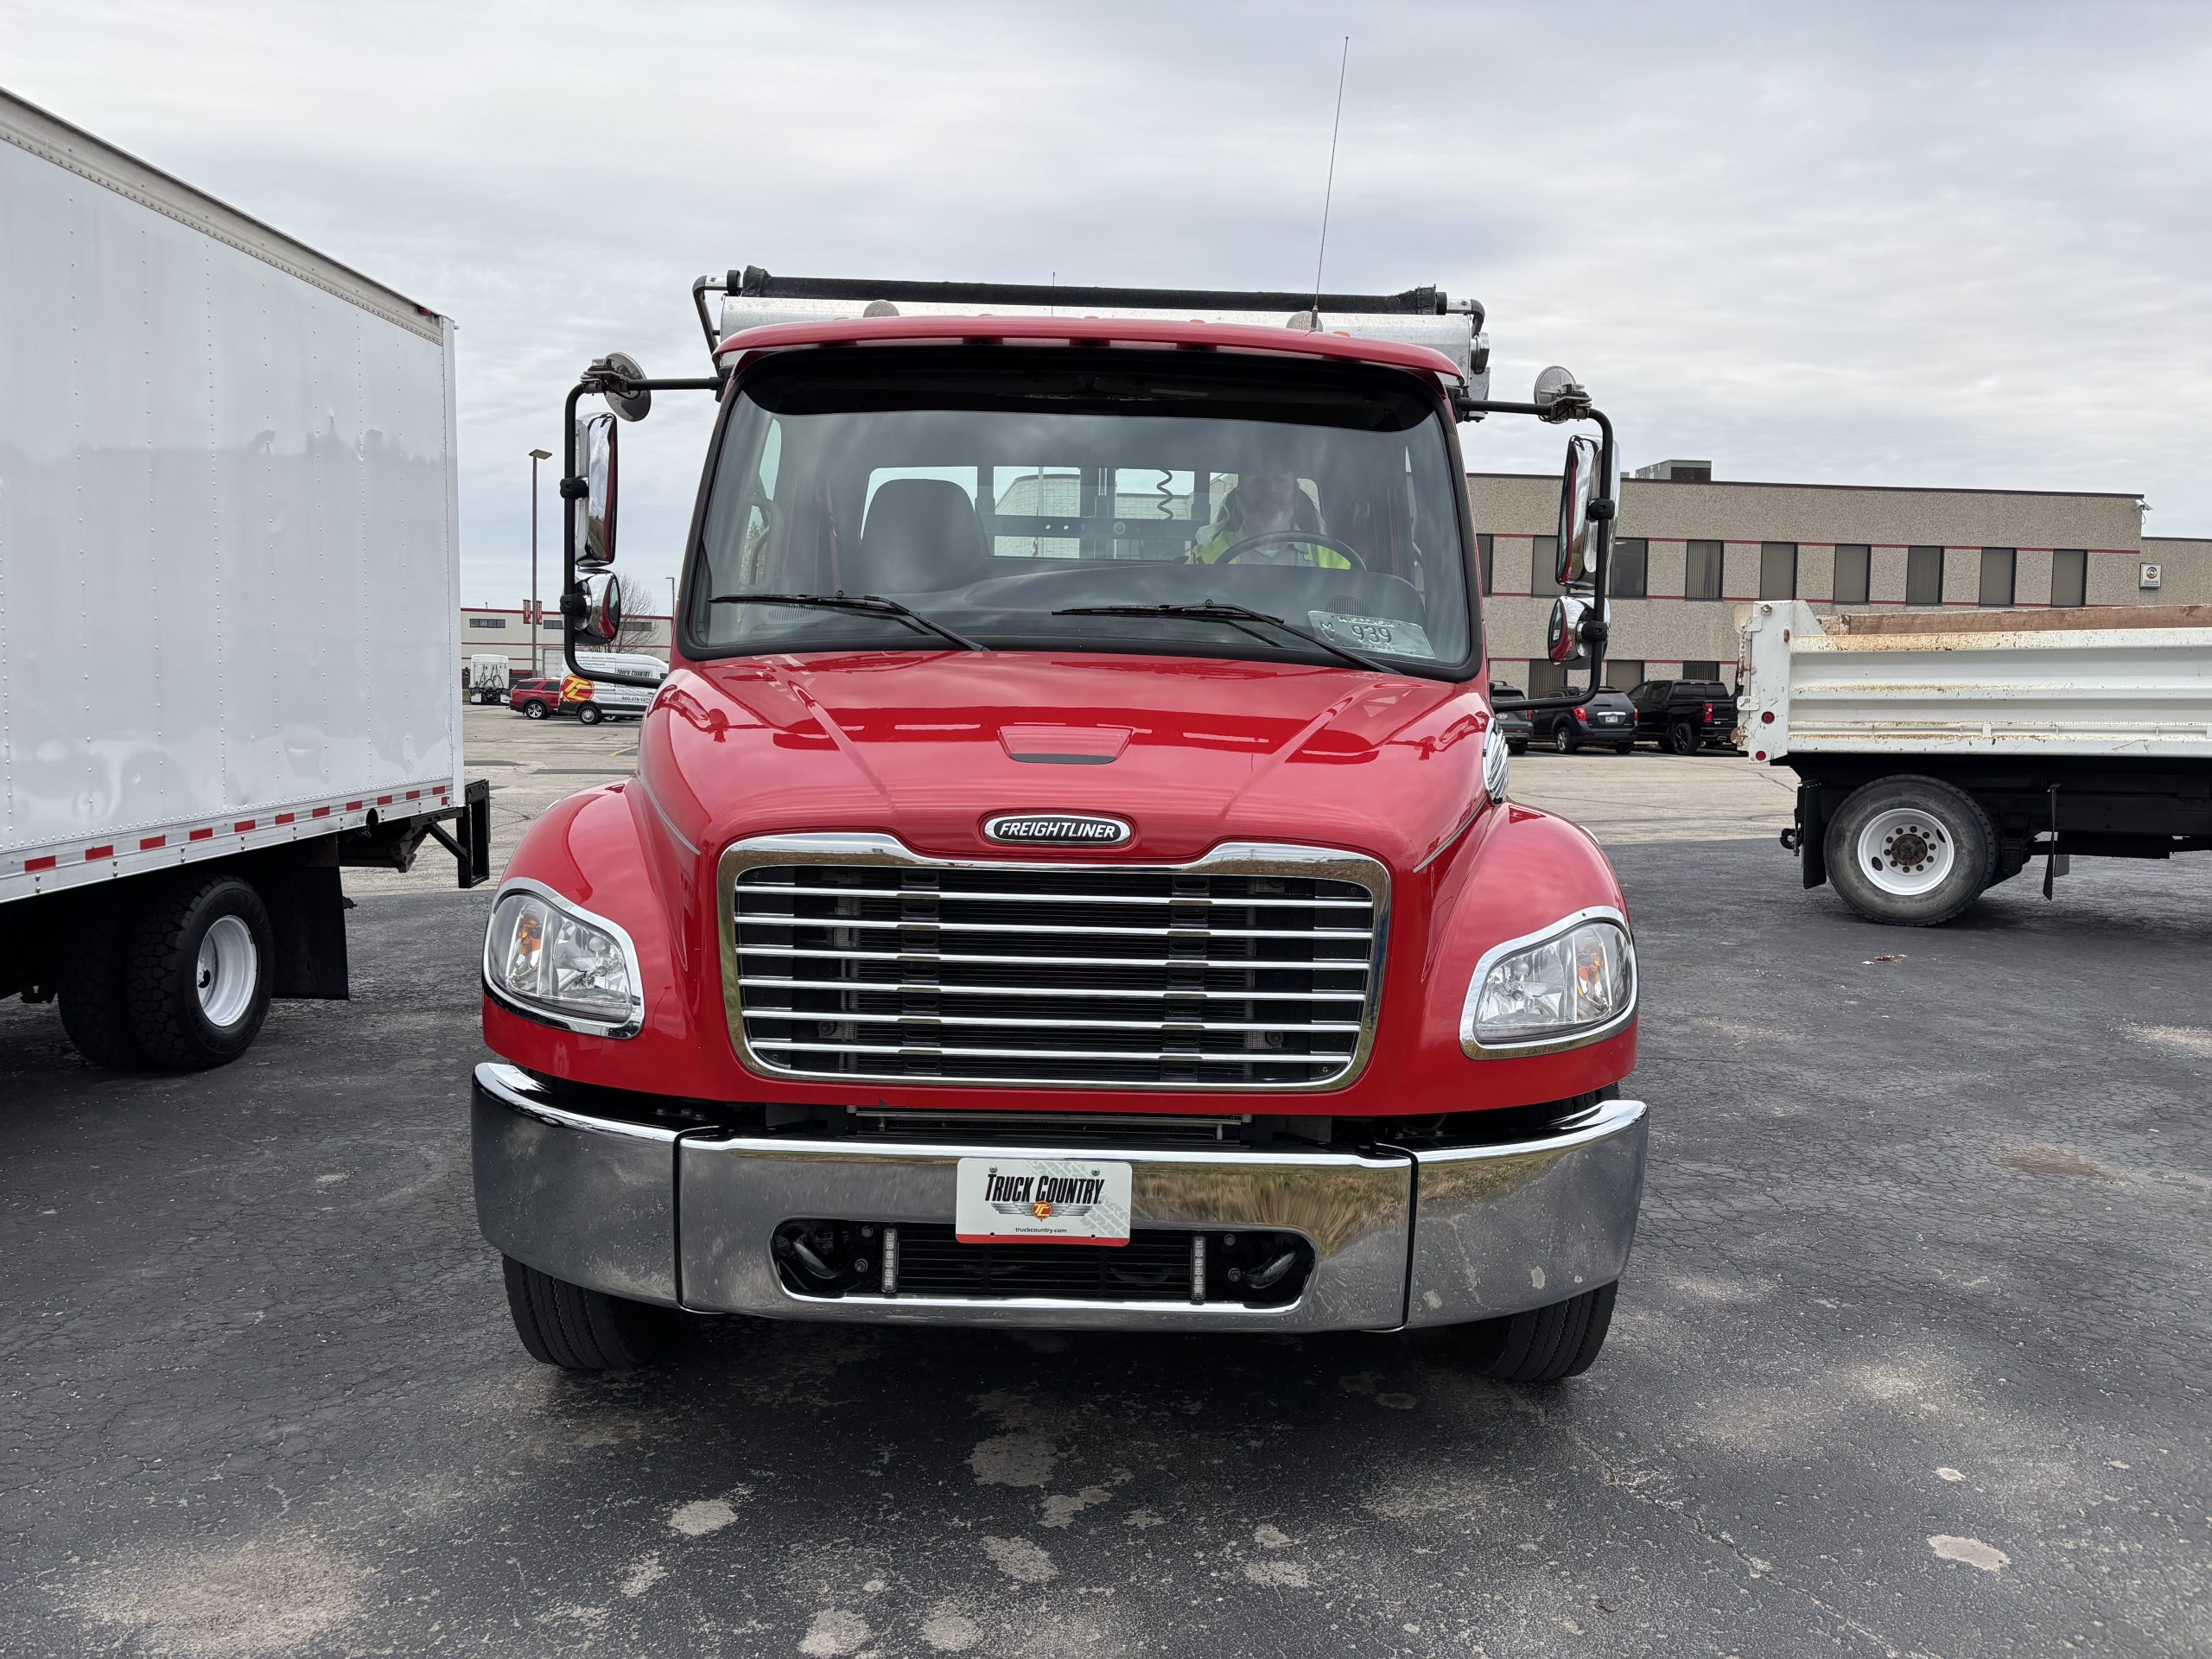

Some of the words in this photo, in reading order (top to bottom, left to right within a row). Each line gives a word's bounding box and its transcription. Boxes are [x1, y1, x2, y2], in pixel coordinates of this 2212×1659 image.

[1351, 624, 1393, 645] 939
[999, 822, 1116, 838] FREIGHTLINER
[985, 1173, 1034, 1203] TRUCK
[1035, 1175, 1105, 1205] COUNTRY
[1033, 1204, 1051, 1217] TC
